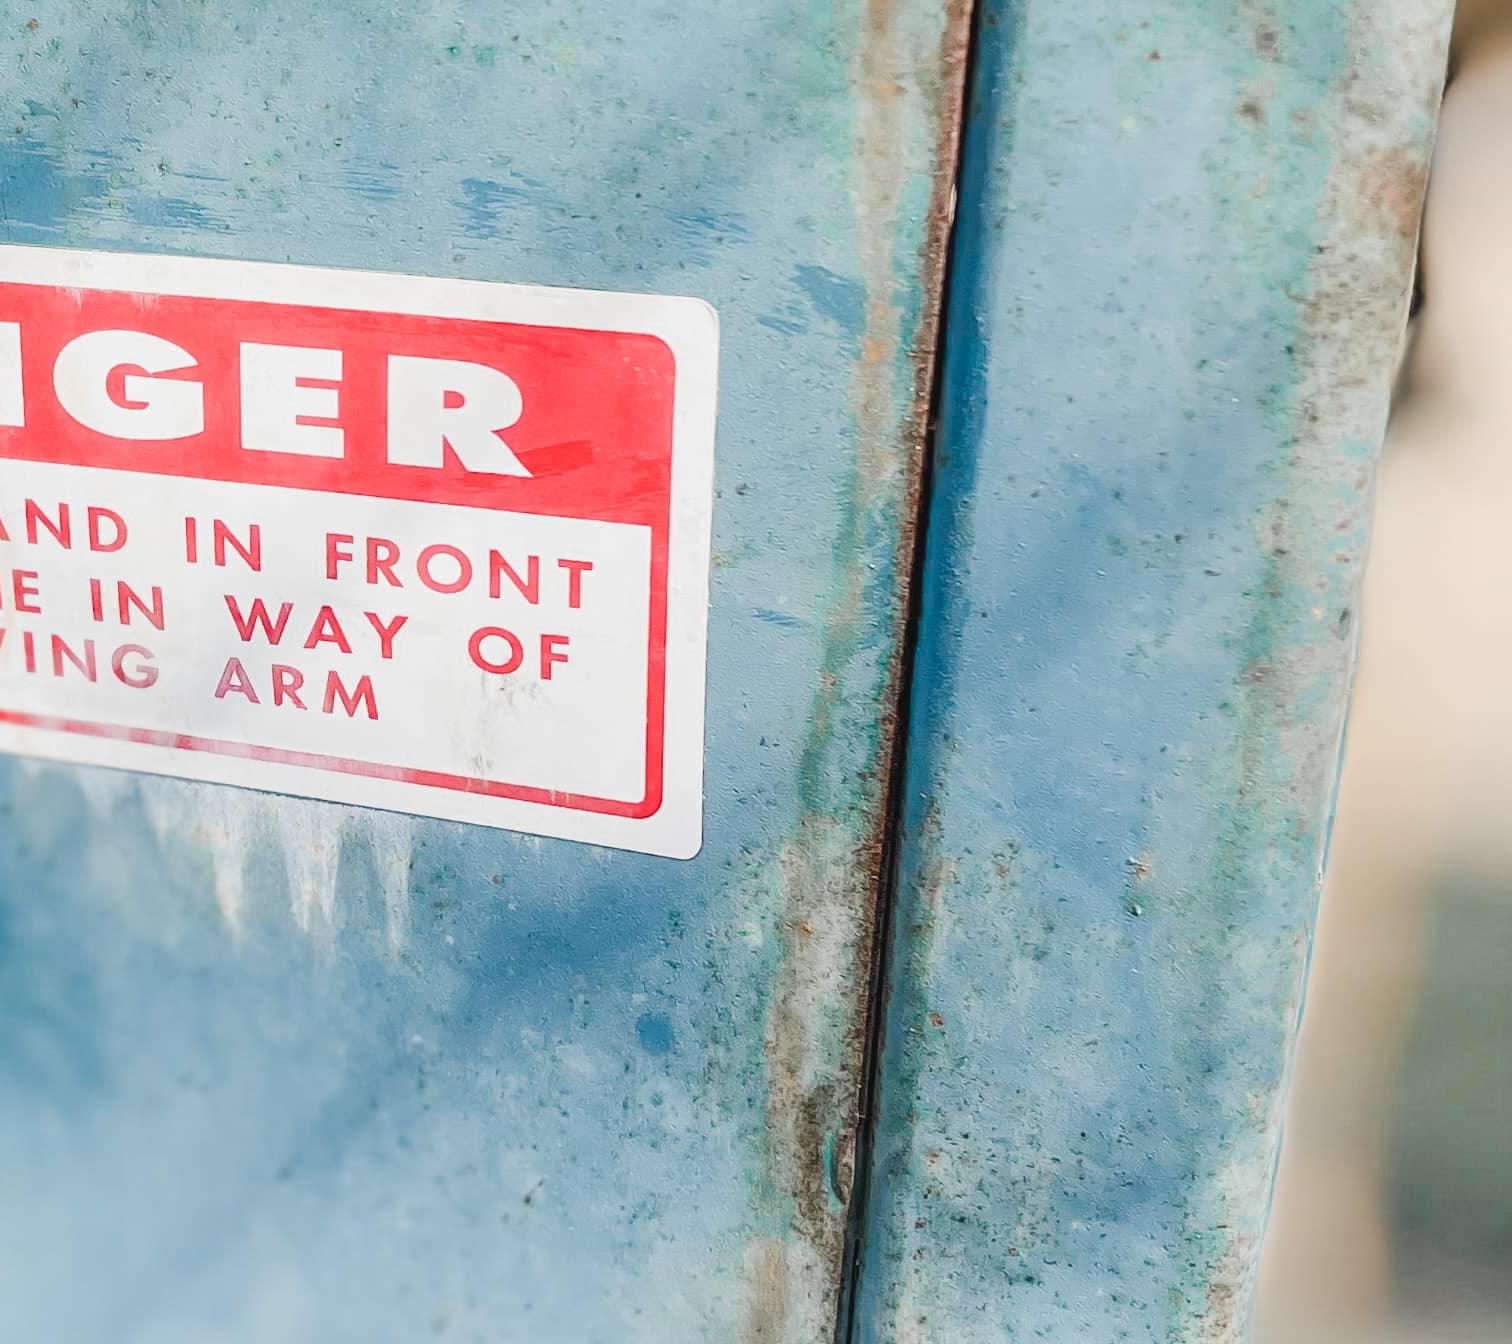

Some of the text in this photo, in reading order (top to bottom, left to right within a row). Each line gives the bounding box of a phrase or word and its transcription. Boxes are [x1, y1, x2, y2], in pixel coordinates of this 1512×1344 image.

[184, 516, 262, 573] IN
[325, 532, 595, 609] FRONT
[90, 578, 165, 631] IN
[224, 594, 409, 660] WAY
[467, 625, 570, 681] OF
[215, 659, 379, 721] ARM
